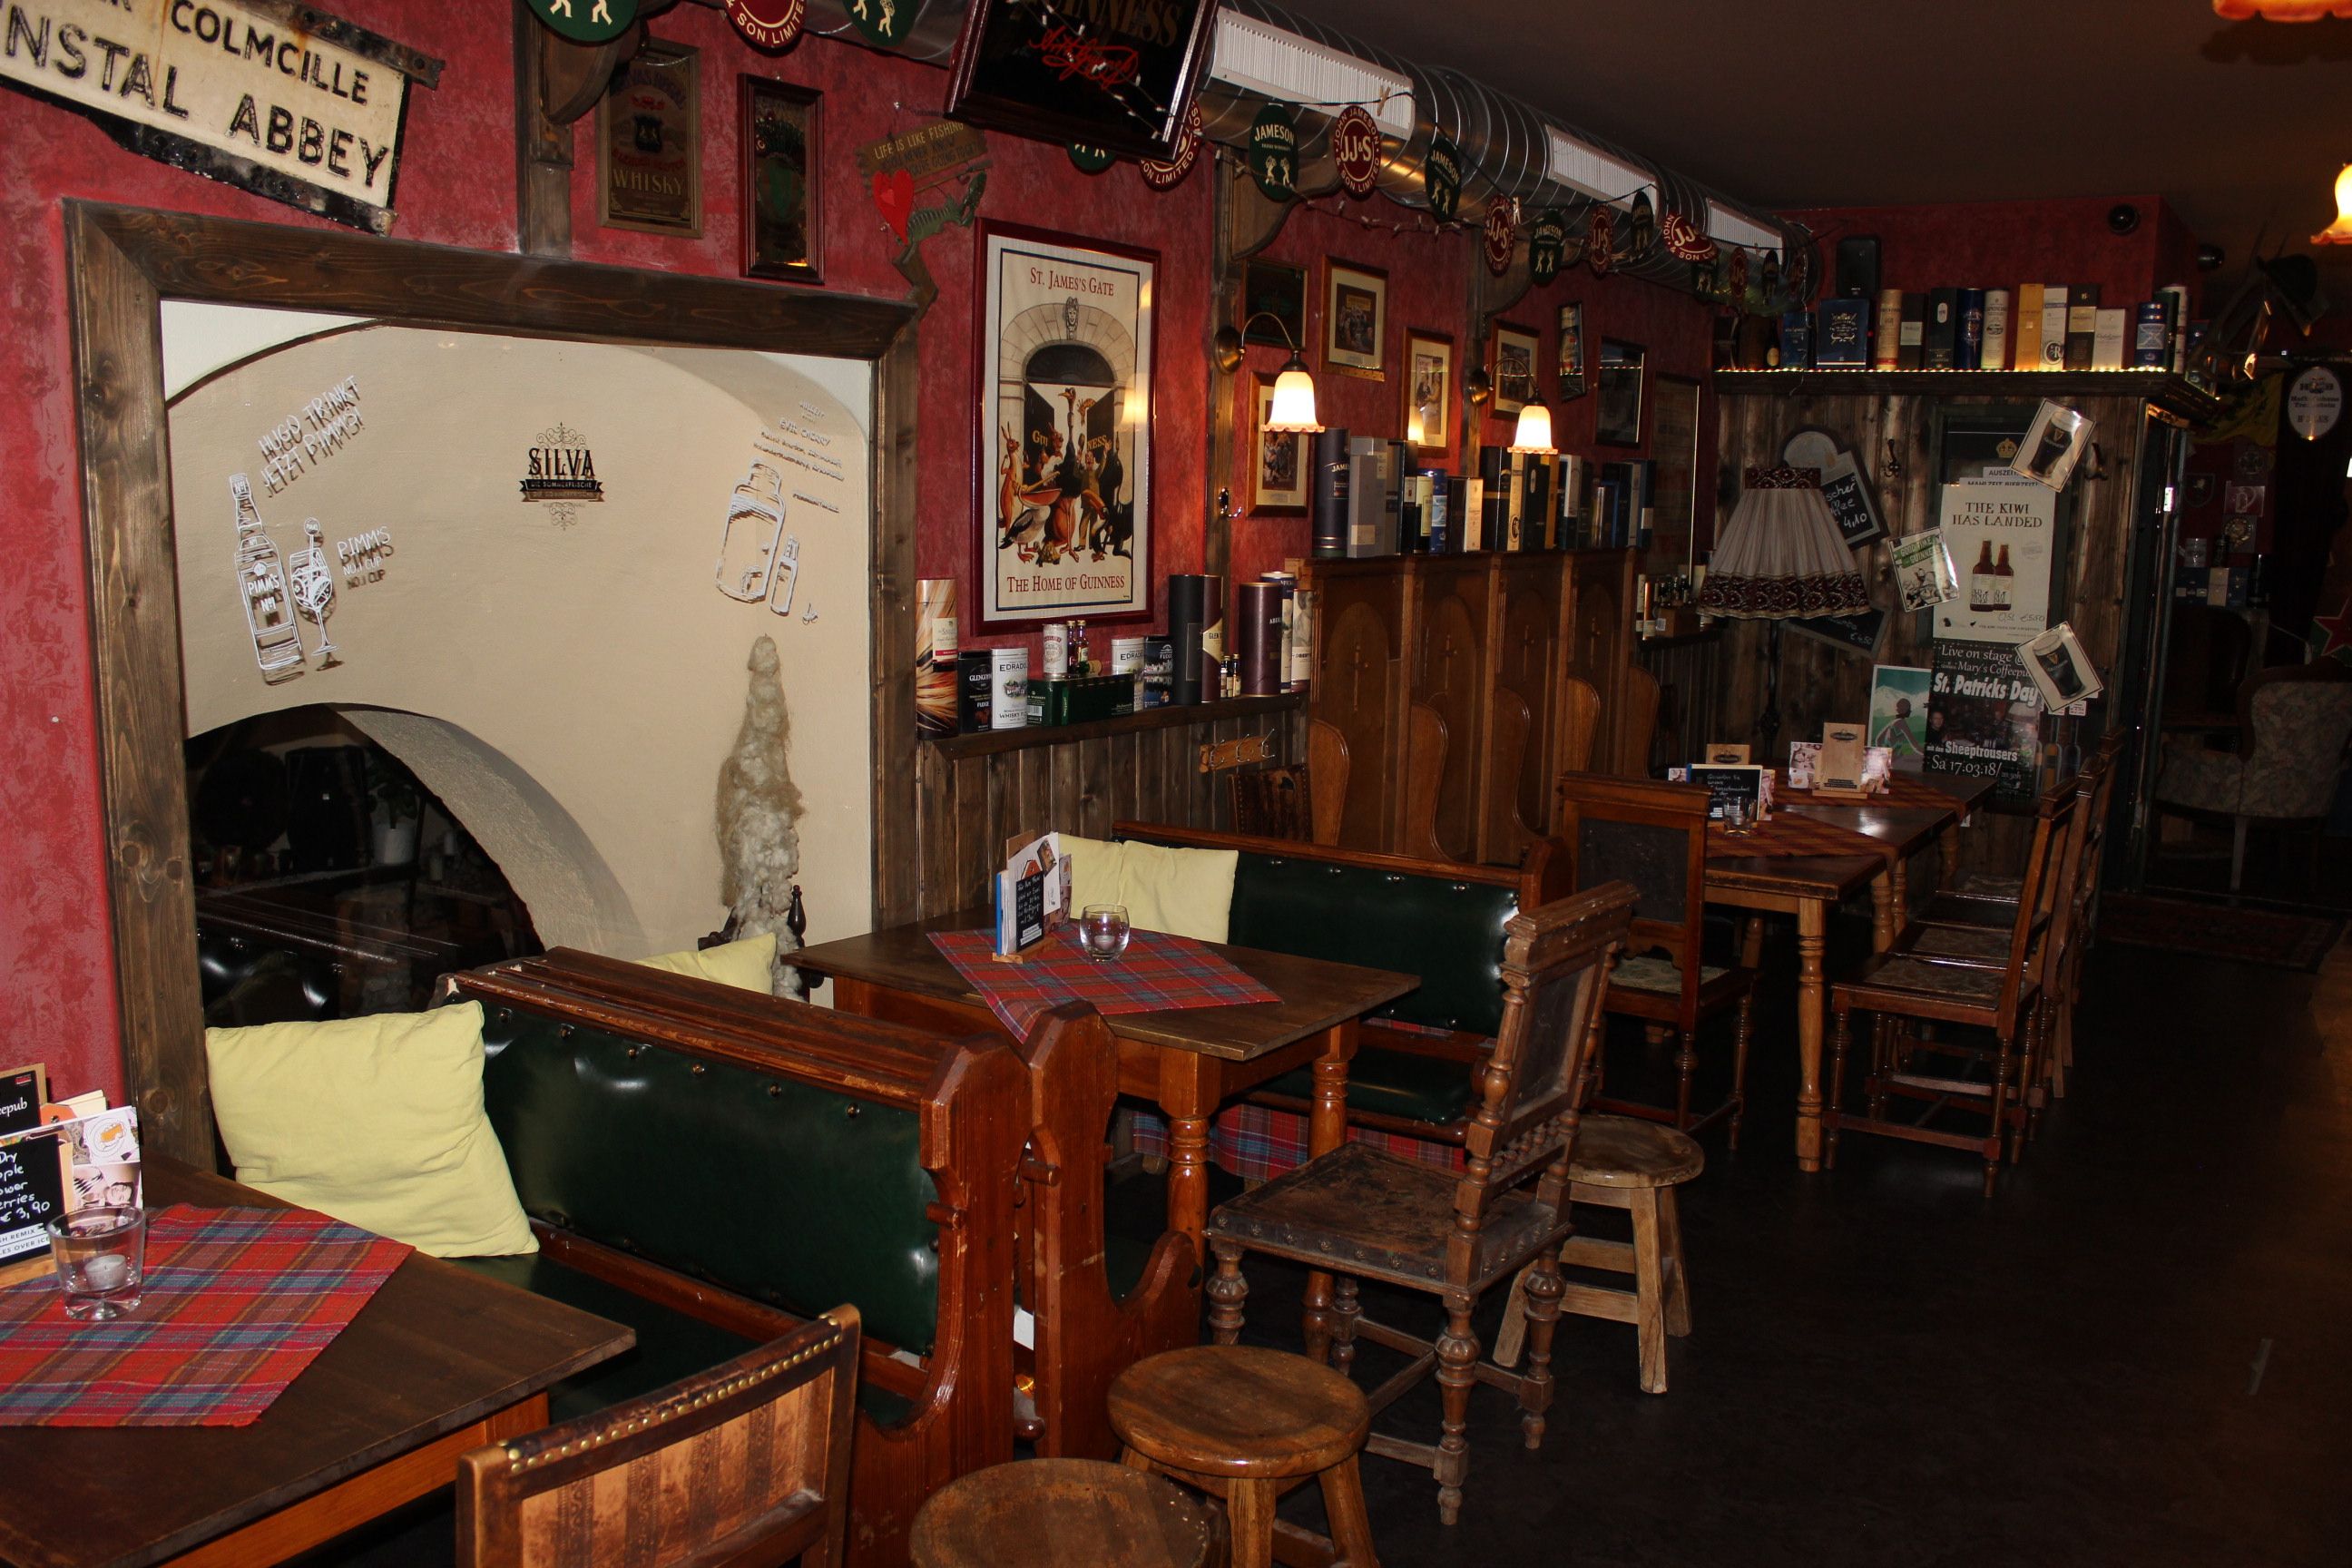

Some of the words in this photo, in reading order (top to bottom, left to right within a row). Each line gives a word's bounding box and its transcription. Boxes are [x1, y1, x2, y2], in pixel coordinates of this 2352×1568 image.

[737, 13, 766, 43] SON
[171, 0, 369, 106] COLMCILLE
[0, 0, 190, 120] NSTAL
[226, 93, 390, 188] ABBEY
[874, 142, 893, 160] LIFE
[895, 140, 905, 152] IS
[907, 132, 926, 147] LIKE
[929, 121, 965, 141] FISHING
[1254, 122, 1295, 144] JAMESON
[1155, 151, 1194, 184] LIMITED
[1430, 150, 1460, 185] JAMESON
[612, 169, 682, 197] WHISKY
[1534, 224, 1563, 240] JAMESON
[1663, 214, 1675, 240] JOHN
[1030, 267, 1044, 286] ST.
[1048, 270, 1087, 292] JAMES'S
[1089, 277, 1114, 297] GATE
[259, 415, 301, 456] HUGO
[303, 375, 359, 423] TRINKT
[261, 446, 302, 487] JETZT
[528, 448, 595, 476] SILVA
[1331, 464, 1349, 473] JAME
[1822, 483, 1856, 502] scher
[1965, 502, 1994, 514] THE
[2000, 503, 2029, 514] KIWI
[1953, 514, 1980, 525] HAS
[1984, 515, 2043, 527] LANDED
[365, 556, 382, 571] CUP
[1007, 576, 1030, 593] THE
[1032, 575, 1063, 592] HOME
[1064, 576, 1077, 591] OF
[1080, 573, 1125, 590] GUINNESS
[1942, 644, 1964, 657] Live
[1965, 650, 1980, 659] on
[1983, 650, 2013, 666] stage
[1000, 662, 1028, 672] EDRADO
[1989, 664, 2030, 680] Coffeepu
[1933, 671, 1950, 694] St.
[1953, 674, 2007, 700] Patricks
[2009, 681, 2038, 707] Day
[1945, 740, 2018, 762] Sheeptrousers
[1931, 754, 1947, 771] Sa
[11, 1229, 35, 1240] REMIX
[14, 1241, 35, 1250] OVER
